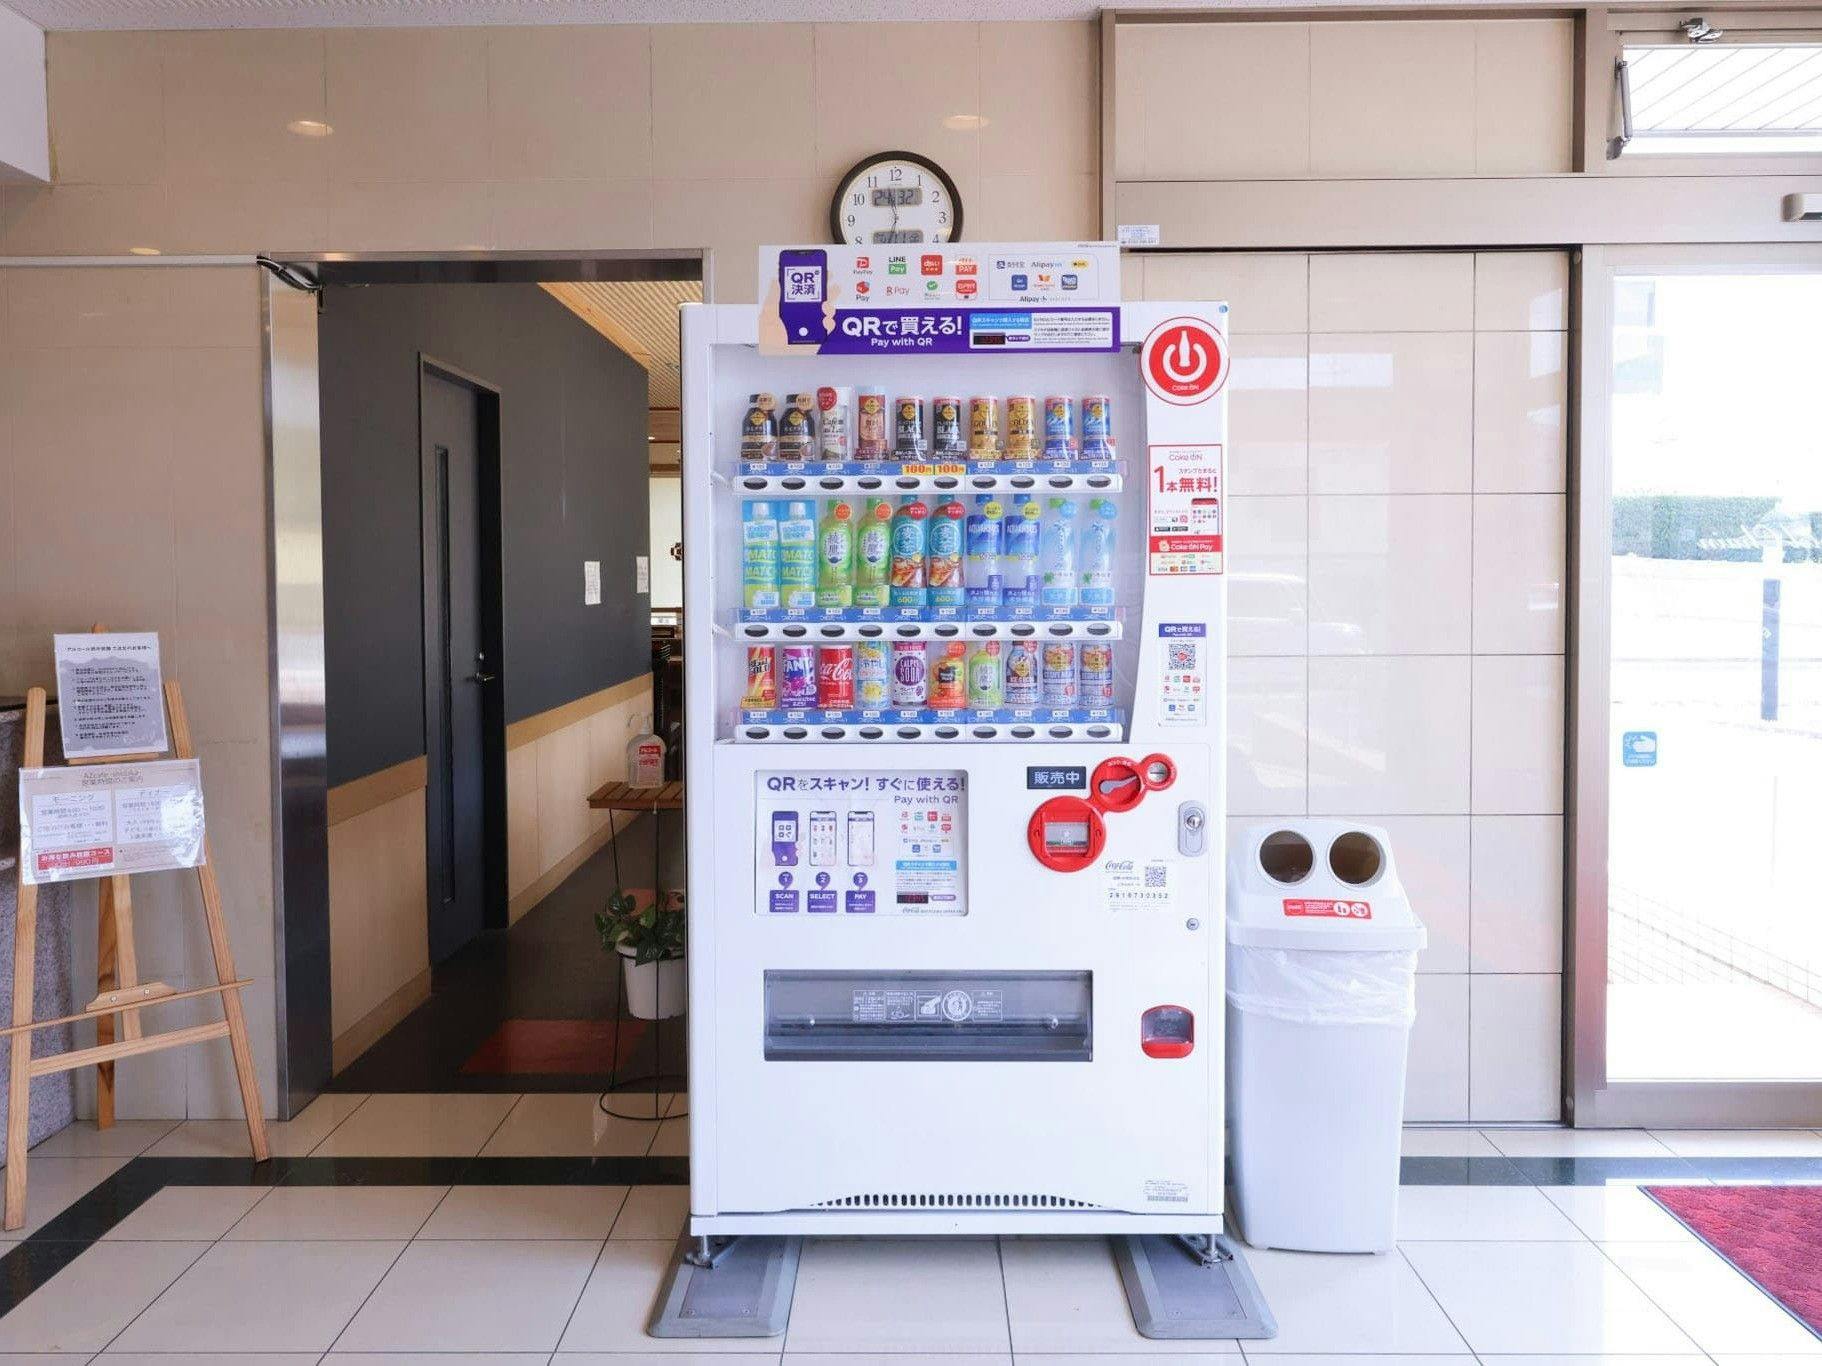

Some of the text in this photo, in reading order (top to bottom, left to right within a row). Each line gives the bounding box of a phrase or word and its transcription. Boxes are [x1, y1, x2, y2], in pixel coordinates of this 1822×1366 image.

[890, 169, 902, 181] 12
[868, 176, 877, 188] 11
[854, 194, 865, 206] 10
[932, 191, 939, 203] 2
[847, 215, 855, 227] 9
[939, 211, 947, 223] 3
[890, 265, 905, 274] Pay
[790, 272, 815, 285] QR
[791, 284, 815, 296] 決済
[842, 316, 963, 337] QRで買える!
[871, 337, 933, 347] Pay with QR
[1154, 465, 1218, 493] 1本無料!
[767, 776, 966, 792] QRをスキャン! すぐに使える!
[1034, 771, 1080, 785] 販売中
[894, 795, 959, 805] Pay with QR
